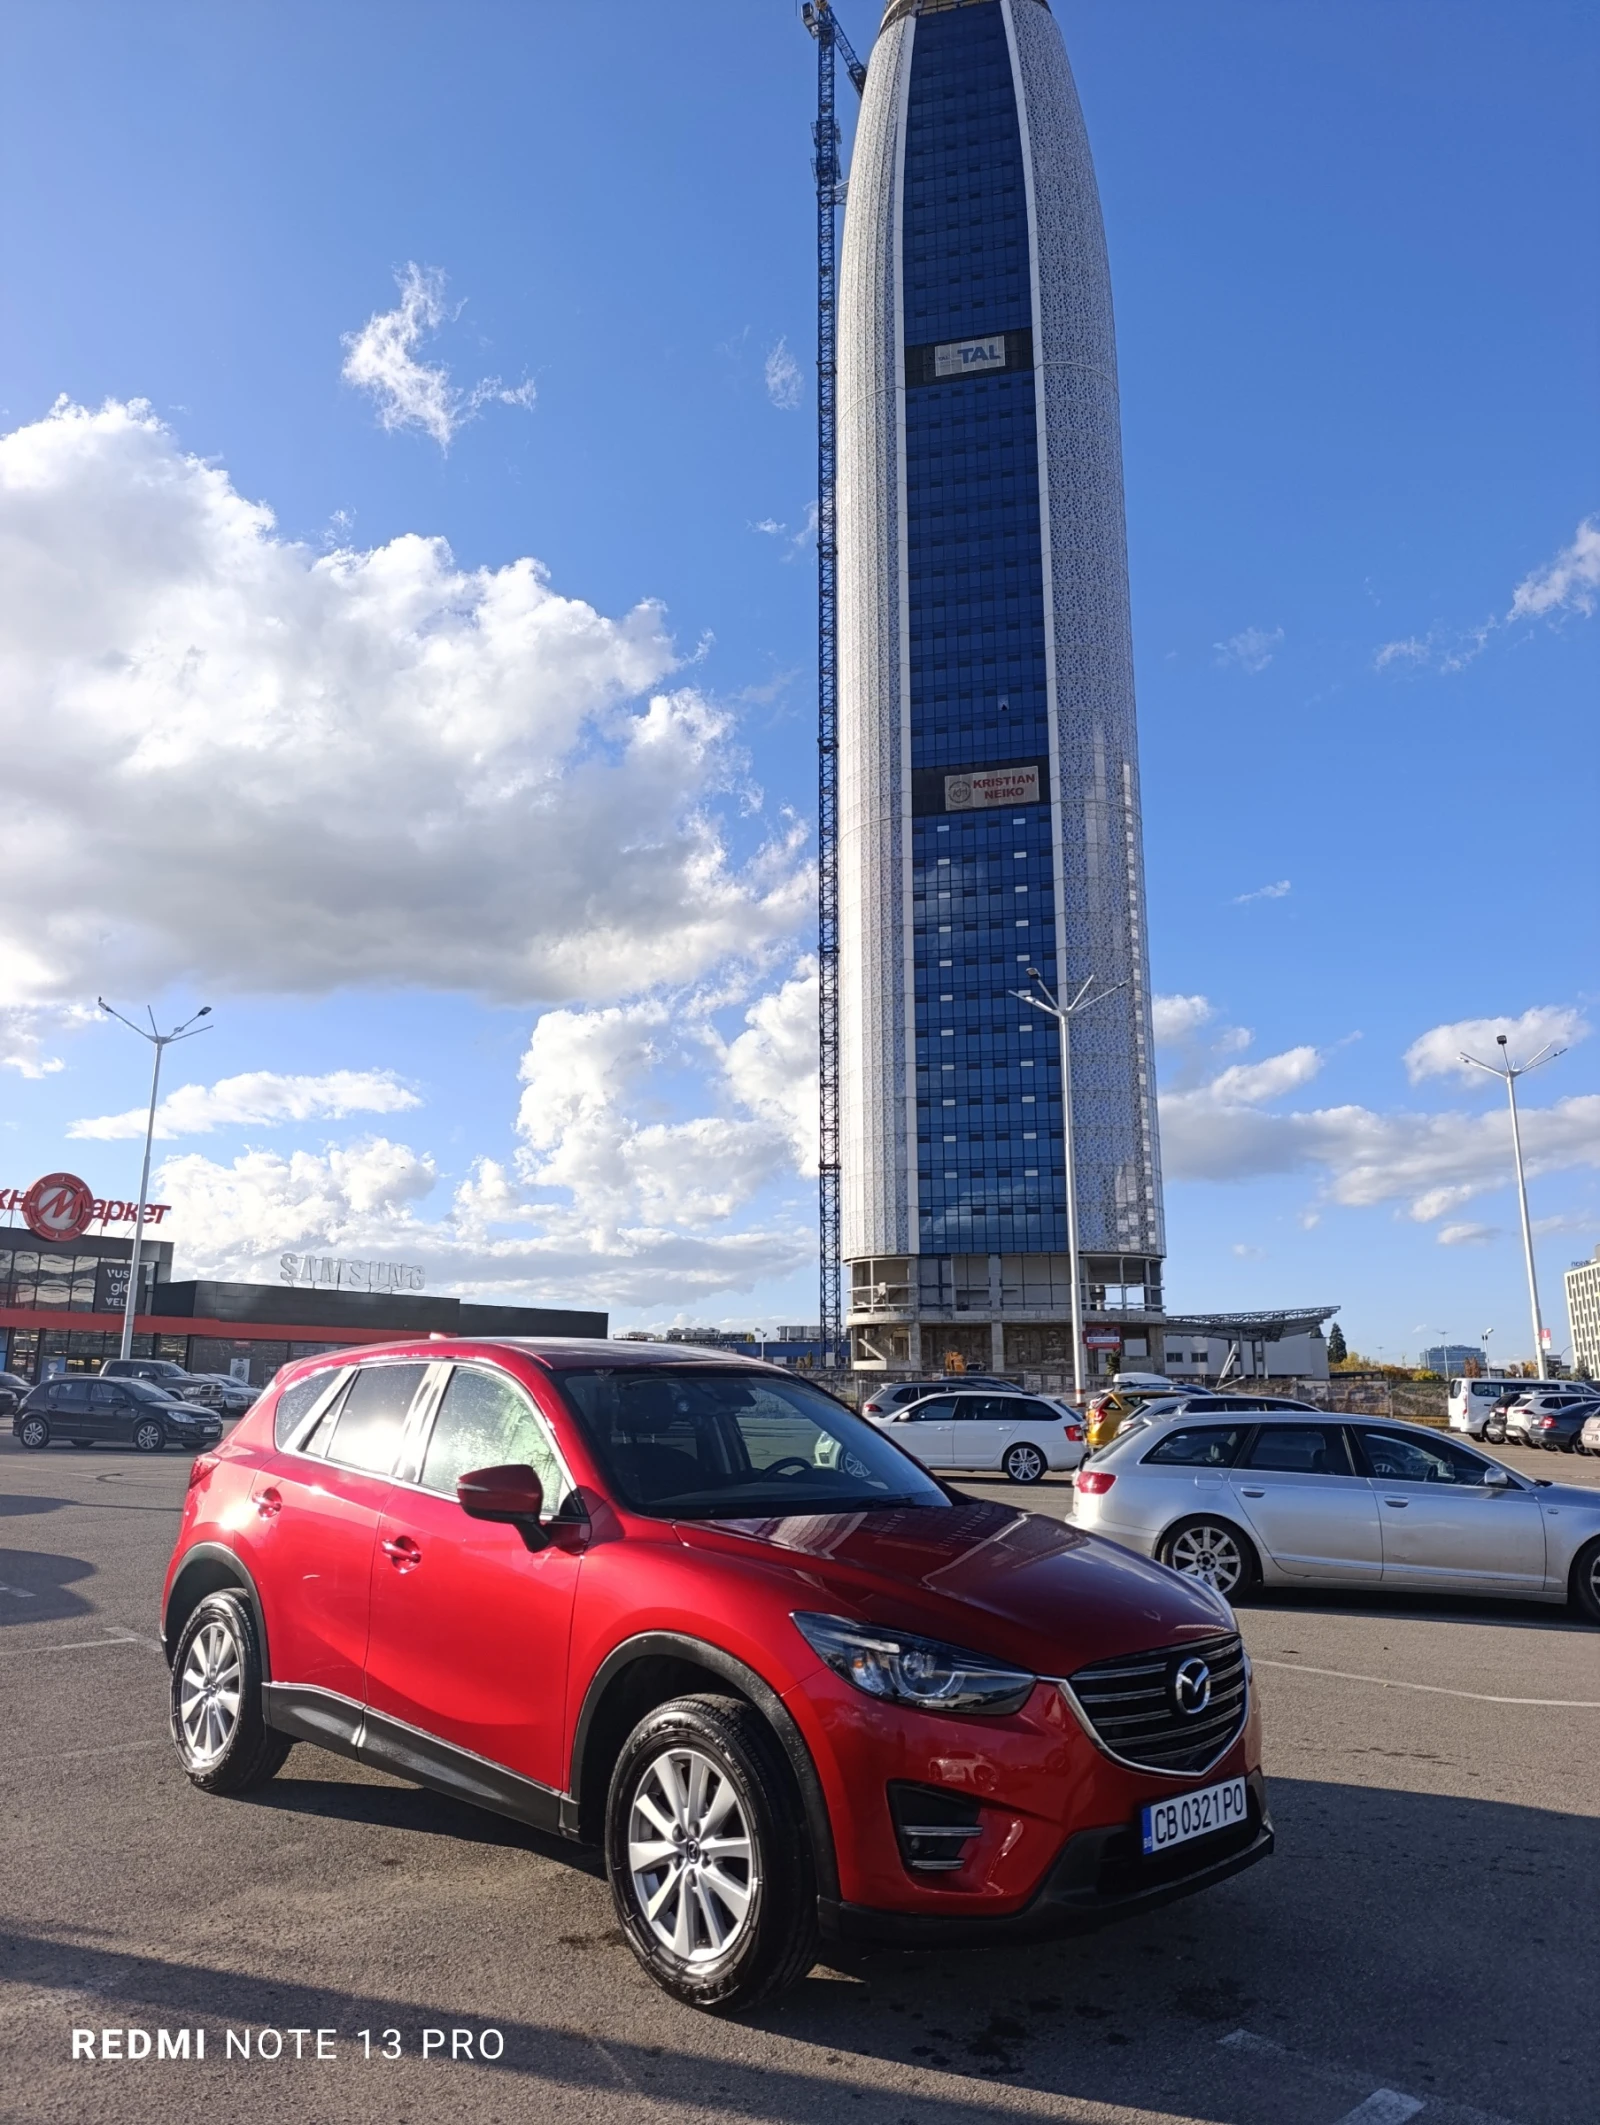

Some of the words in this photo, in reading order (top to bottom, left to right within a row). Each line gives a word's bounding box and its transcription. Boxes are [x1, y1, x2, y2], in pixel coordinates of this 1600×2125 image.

[957, 344, 1002, 364] TAL
[973, 773, 1036, 789] KRISTIAN
[984, 787, 1025, 800] NEIKO
[280, 1252, 426, 1291] SAMSUNG
[1154, 1804, 1178, 1844] CB
[1181, 1790, 1220, 1835] 0321
[1223, 1783, 1244, 1821] PO
